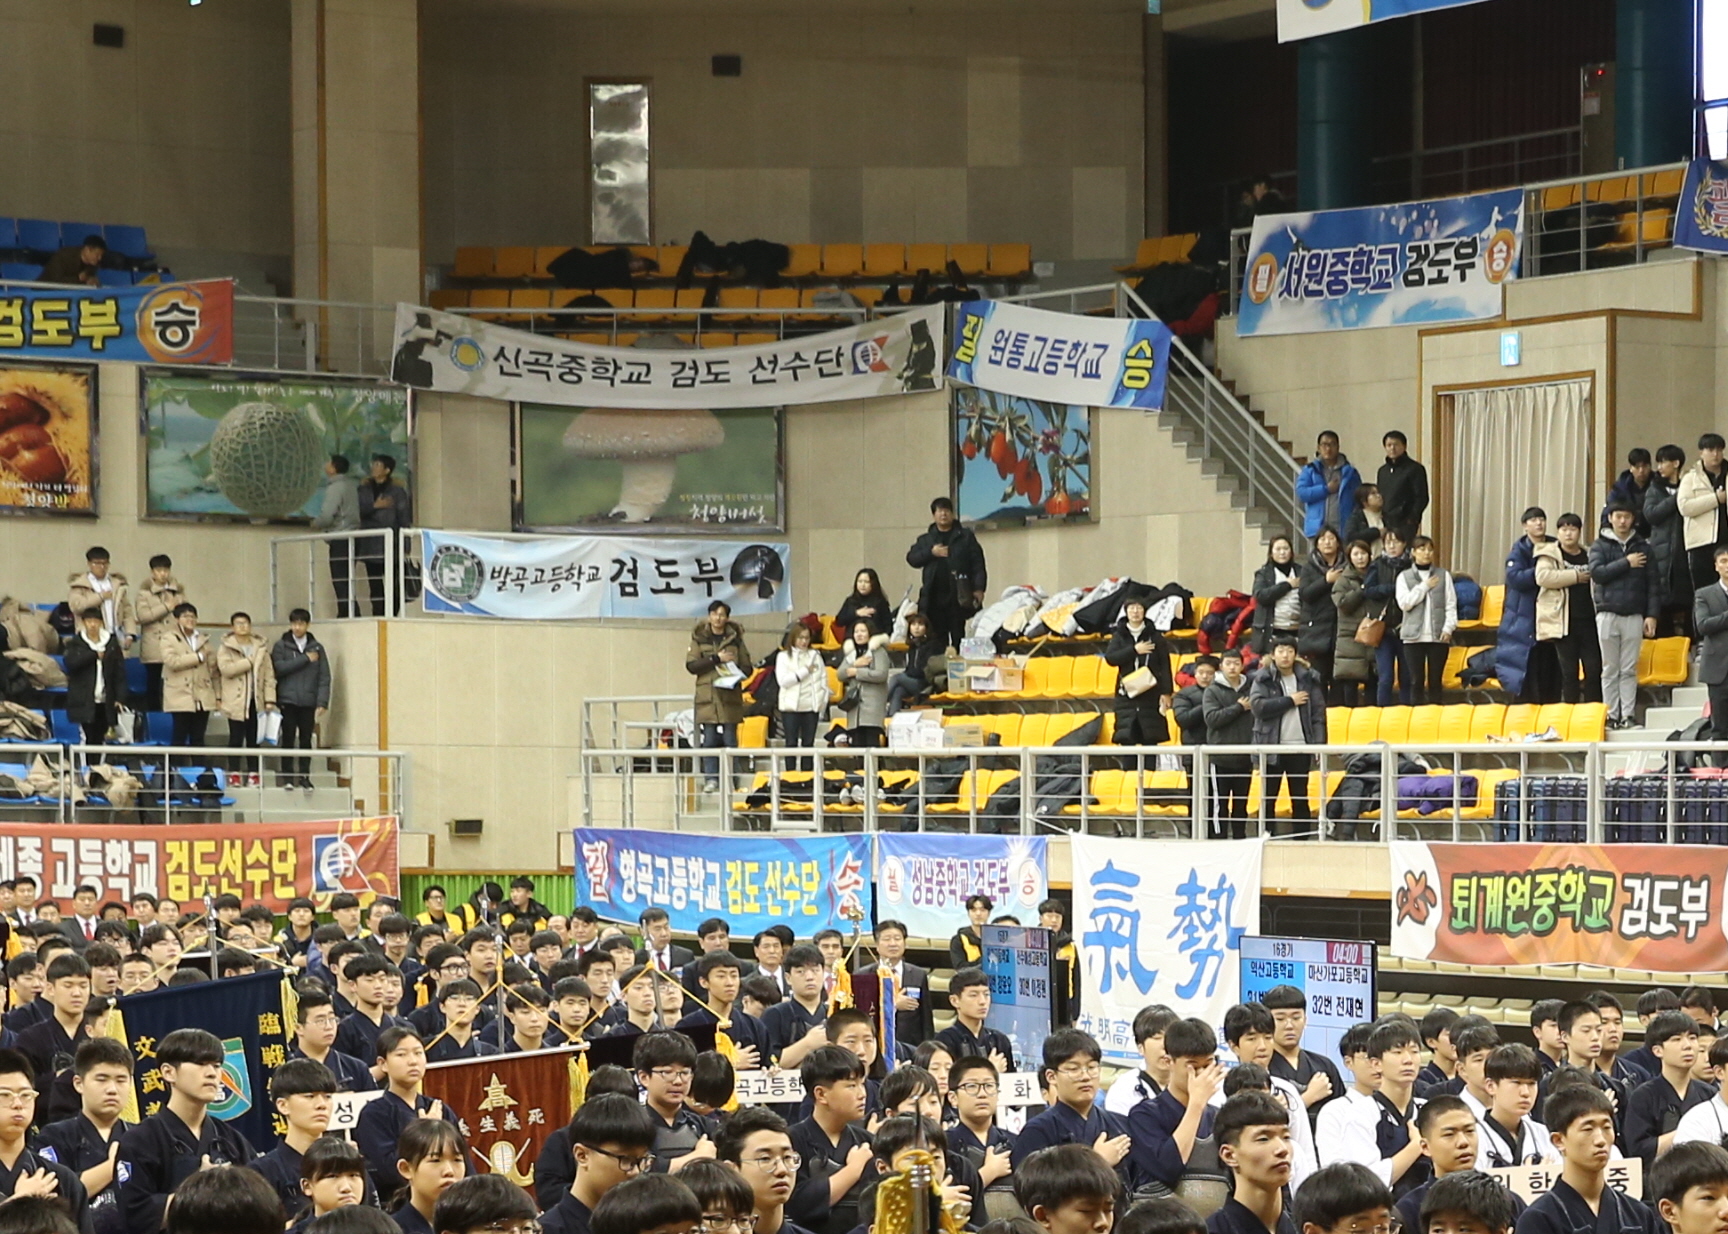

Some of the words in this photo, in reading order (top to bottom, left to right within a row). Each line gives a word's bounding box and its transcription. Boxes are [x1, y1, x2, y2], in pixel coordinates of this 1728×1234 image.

[1279, 246, 1400, 300] 서원중학교
[1402, 234, 1479, 288] 검도부
[1489, 238, 1514, 272] 승
[151, 300, 200, 351] 승
[492, 344, 652, 388] 신곡중학교
[670, 358, 731, 388] 검도
[748, 346, 845, 386] 선수단
[987, 328, 1109, 381] 원통고등학교
[1122, 339, 1154, 391] 승
[689, 503, 767, 524] 청양버섯
[490, 563, 602, 593] 발곡고등학교
[610, 556, 727, 600] 검도부
[51, 838, 159, 902] 고등학교
[165, 838, 298, 903] 검도선수단
[725, 859, 761, 915] 검도
[764, 859, 822, 917] 선수단
[1450, 867, 1616, 937] 퇴계원중학교
[1621, 873, 1709, 938] 검도부
[1083, 859, 1247, 999] 氣勢
[1250, 962, 1294, 979] 익산고등학교
[1272, 942, 1294, 958] 16경기
[1332, 944, 1359, 964] 04:00
[1312, 995, 1333, 1015] 32번
[334, 1101, 354, 1123] 성
